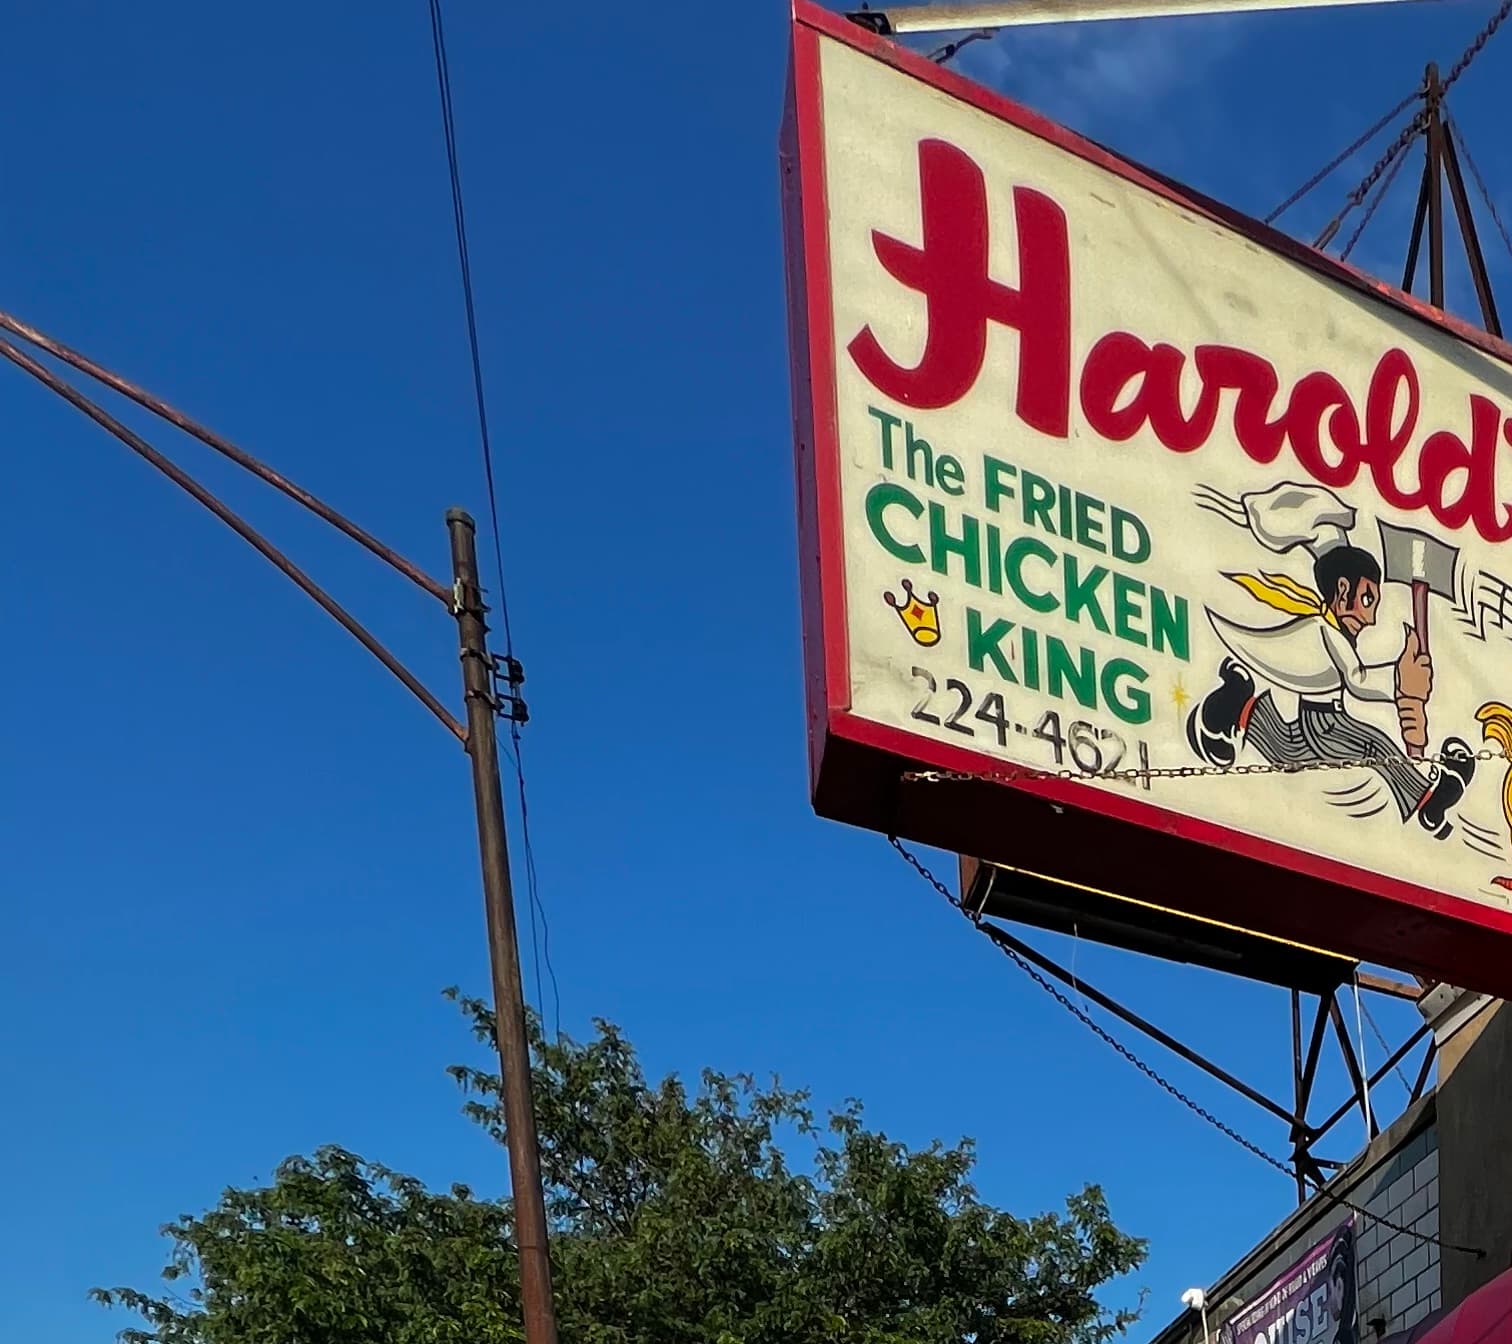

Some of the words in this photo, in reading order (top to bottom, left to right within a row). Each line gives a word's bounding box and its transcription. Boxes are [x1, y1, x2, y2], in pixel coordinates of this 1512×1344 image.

[867, 406, 966, 497] The
[982, 460, 1152, 567] FRIED
[864, 481, 1191, 664] CHICKEN
[910, 666, 1151, 790] 224-4621
[966, 612, 1153, 726] KING
